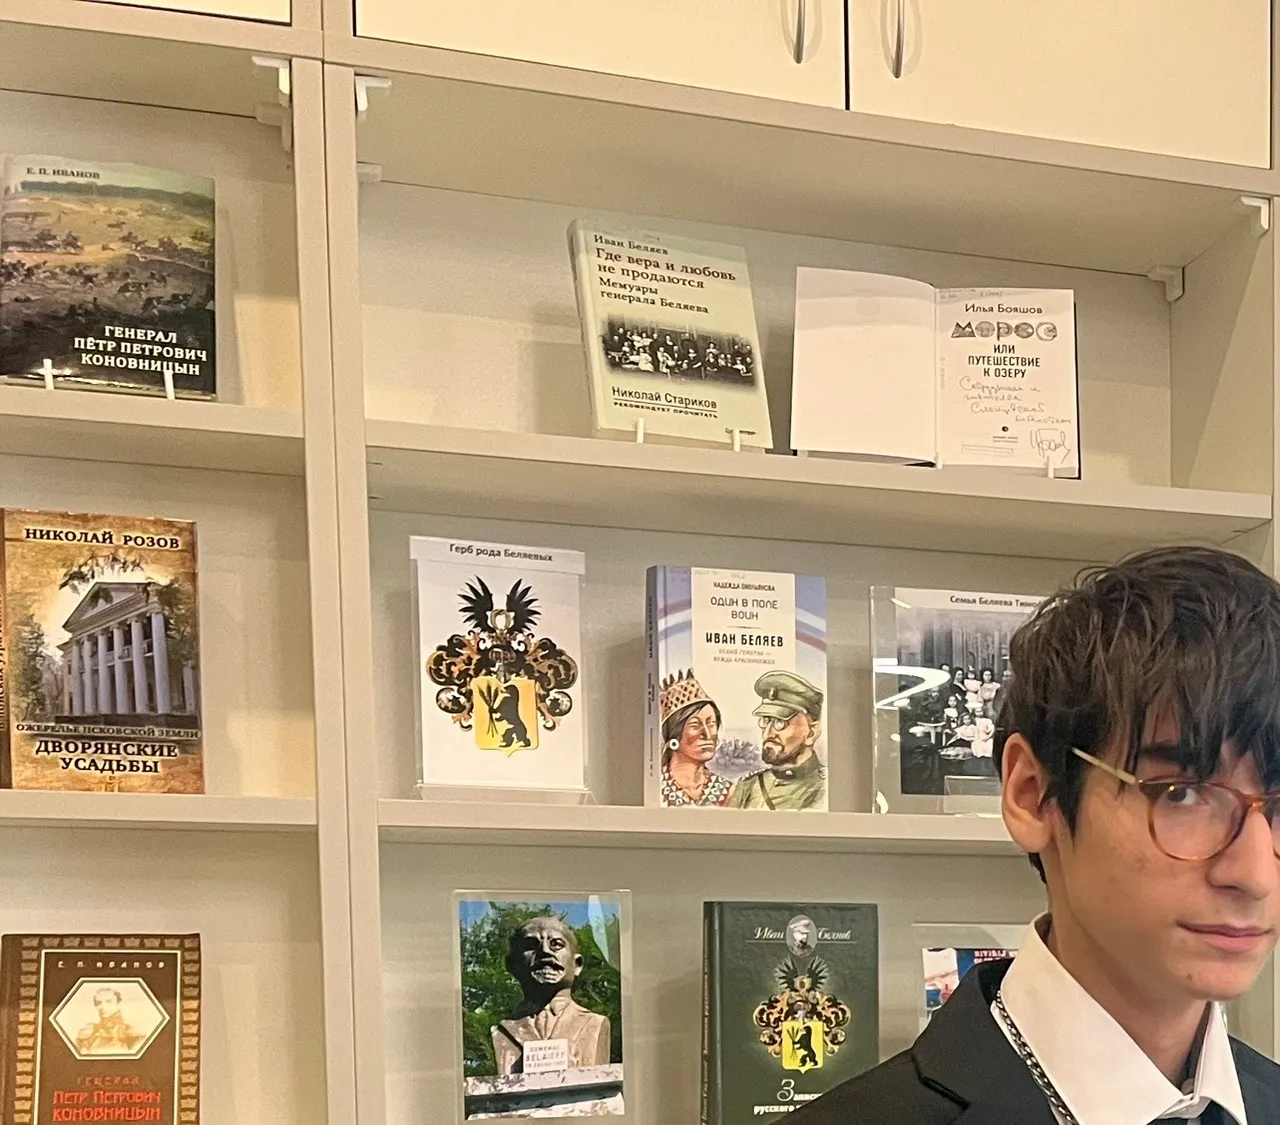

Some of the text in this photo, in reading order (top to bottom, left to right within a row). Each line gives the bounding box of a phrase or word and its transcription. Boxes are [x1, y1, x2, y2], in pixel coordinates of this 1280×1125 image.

[53, 168, 100, 179] ИВАНОВ
[593, 234, 668, 255] Иван Беляев
[595, 248, 736, 281] Где вера и любовь
[597, 263, 705, 289] не продаются
[599, 277, 658, 295] Мемуары
[600, 291, 709, 314] генерала Беляева
[965, 303, 1043, 314] Илья Бояшов
[104, 325, 177, 344] ГЕНЕРАЛ
[74, 336, 207, 361] ПЁТР ПЕТРОВИЧ
[993, 344, 1015, 354] ИЛИ
[81, 353, 200, 376] КОНОВНИЦЫН
[968, 355, 1041, 368] ПУТЕШЕСТВИЕ
[983, 367, 1027, 378] К ОЗЕРУ
[612, 386, 717, 409] Николай Стариков
[614, 402, 718, 419] РЕКОМЕНДУЕТ ПРОЧИТАТЬ
[25, 528, 180, 549] НИКОЛАЙ РОЗОВ
[449, 543, 553, 561] Герб рода Беляевых
[710, 596, 778, 609] ОДИН В ПОЛЕ
[950, 595, 977, 604] Семья
[978, 597, 1013, 607] Беляева
[731, 610, 759, 620] ВОИН
[706, 632, 784, 647] ИВАН БЕЛЯЕВ
[16, 723, 199, 738] ОЖЕРЕЛЬЕ ПСКОВСКОЙ ЗЕМЛИ
[36, 740, 177, 757] ДВОРЯНСКИЕ
[61, 758, 160, 773] УСАДЬБЫ
[53, 1091, 161, 1104] ПЕТР ПЕТРОВИЧ
[52, 1107, 161, 1122] КОНОВНИЦЫН
[753, 1104, 795, 1115] русского
